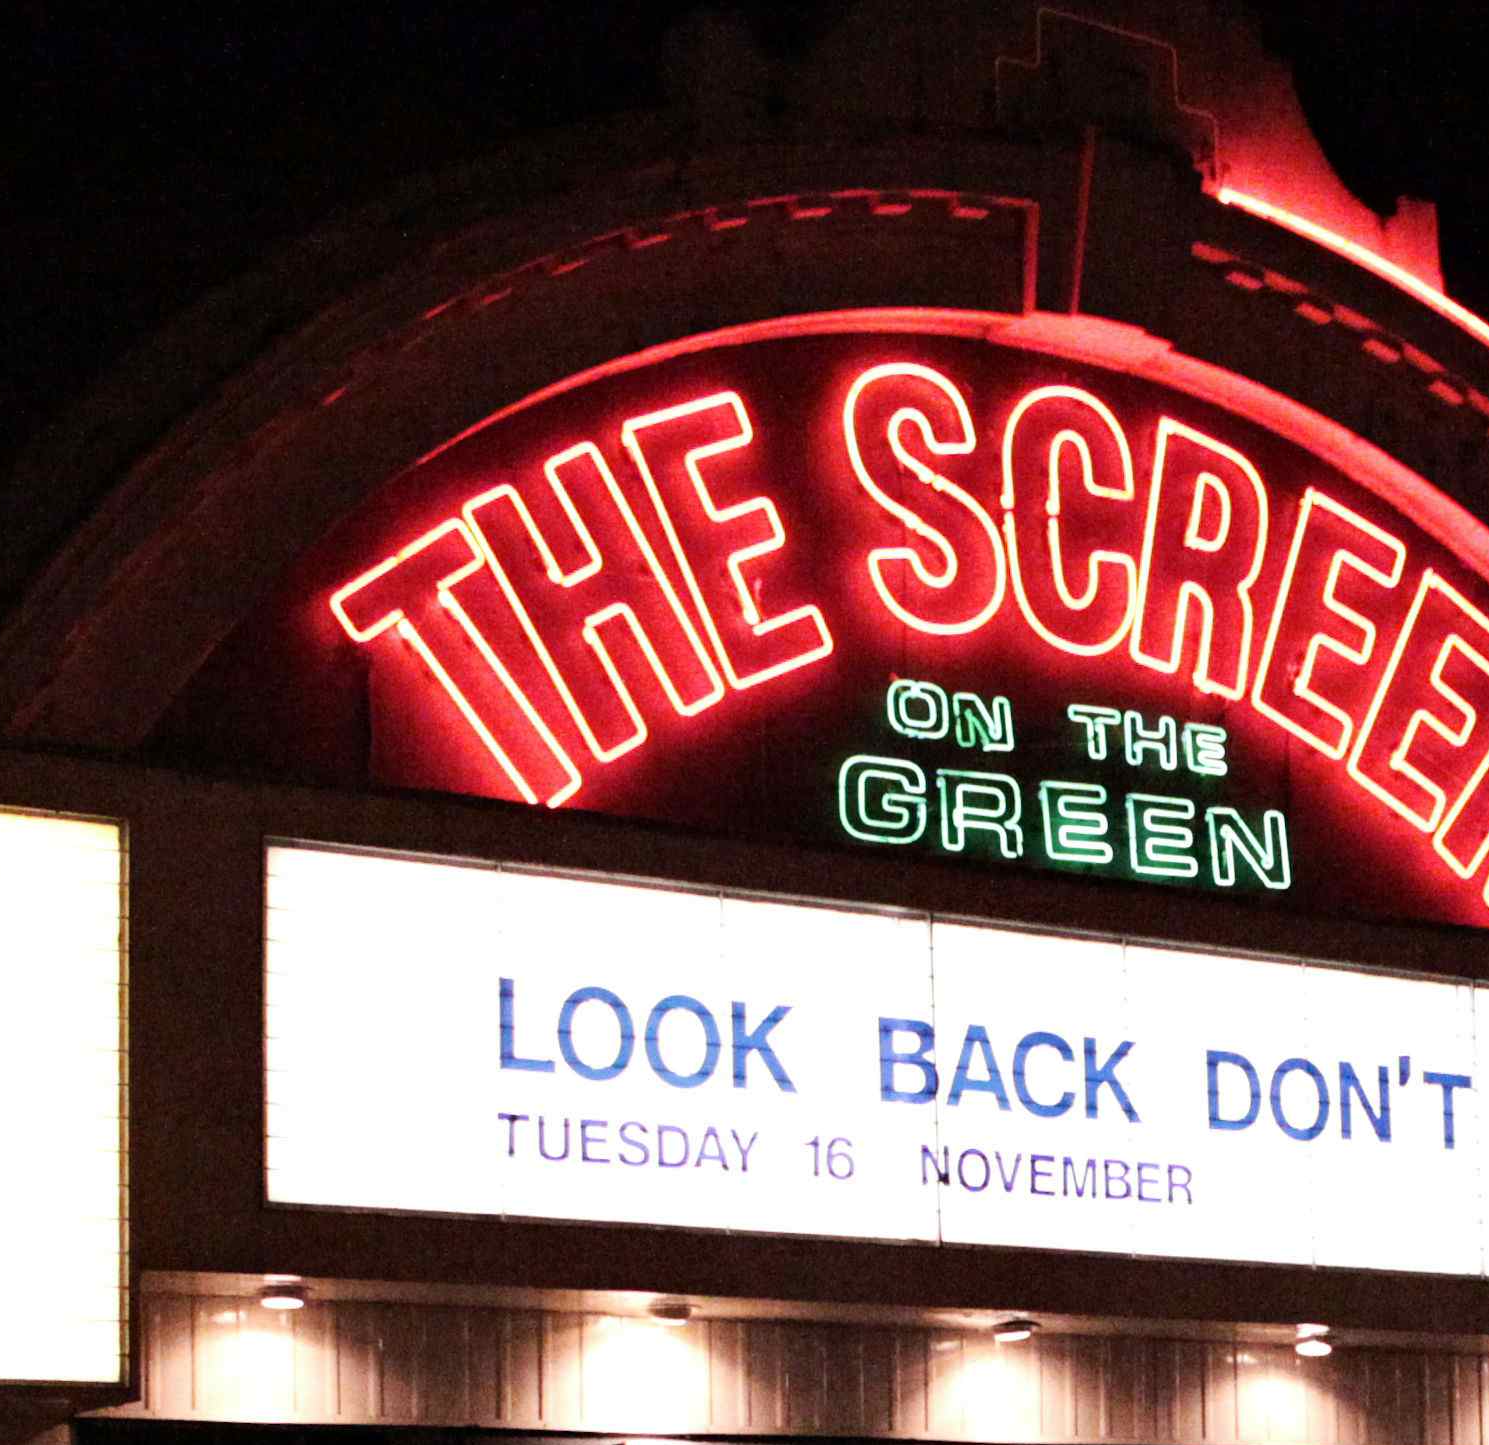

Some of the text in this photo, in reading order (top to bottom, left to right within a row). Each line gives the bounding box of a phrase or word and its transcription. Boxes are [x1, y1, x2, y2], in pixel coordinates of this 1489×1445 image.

[328, 390, 835, 810] THE
[886, 677, 1230, 777] ON THE
[837, 754, 1294, 891] GREEN
[498, 976, 798, 1094] LOOK
[878, 1016, 1142, 1125] BACK
[1205, 1049, 1475, 1150] DON'T
[497, 1112, 1193, 1206] TUESDAY 16 NOVEMBER
